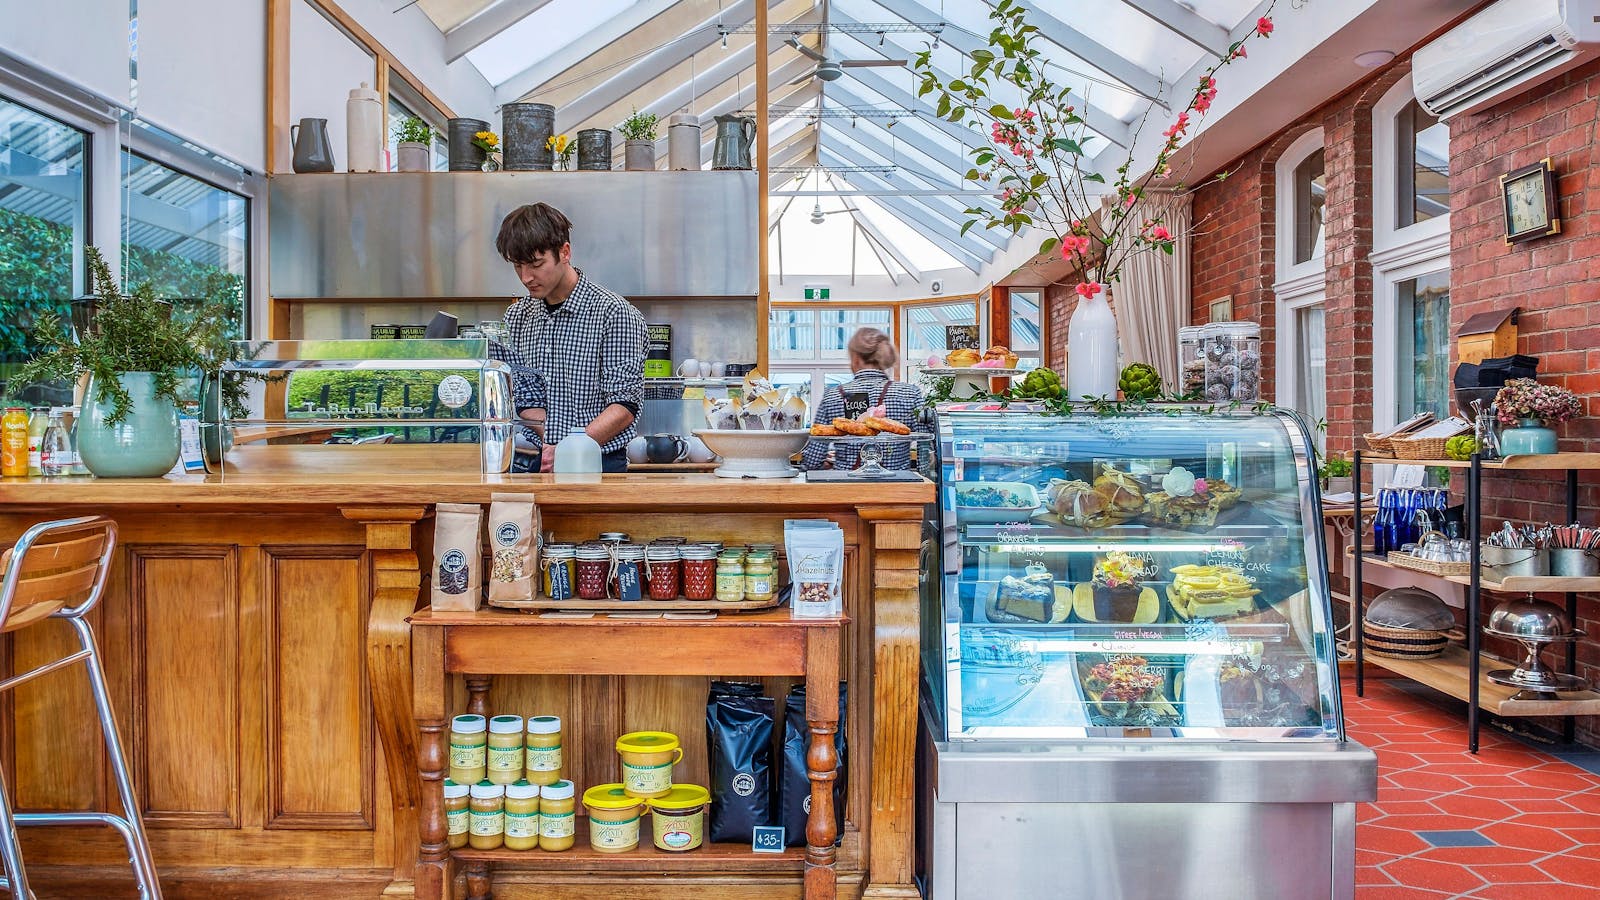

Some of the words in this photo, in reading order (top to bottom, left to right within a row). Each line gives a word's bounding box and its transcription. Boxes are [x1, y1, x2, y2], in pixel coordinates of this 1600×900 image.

[800, 566, 835, 575] Hazelnuts
[1246, 561, 1272, 574] CAKE
[1102, 652, 1134, 662] VEGAN
